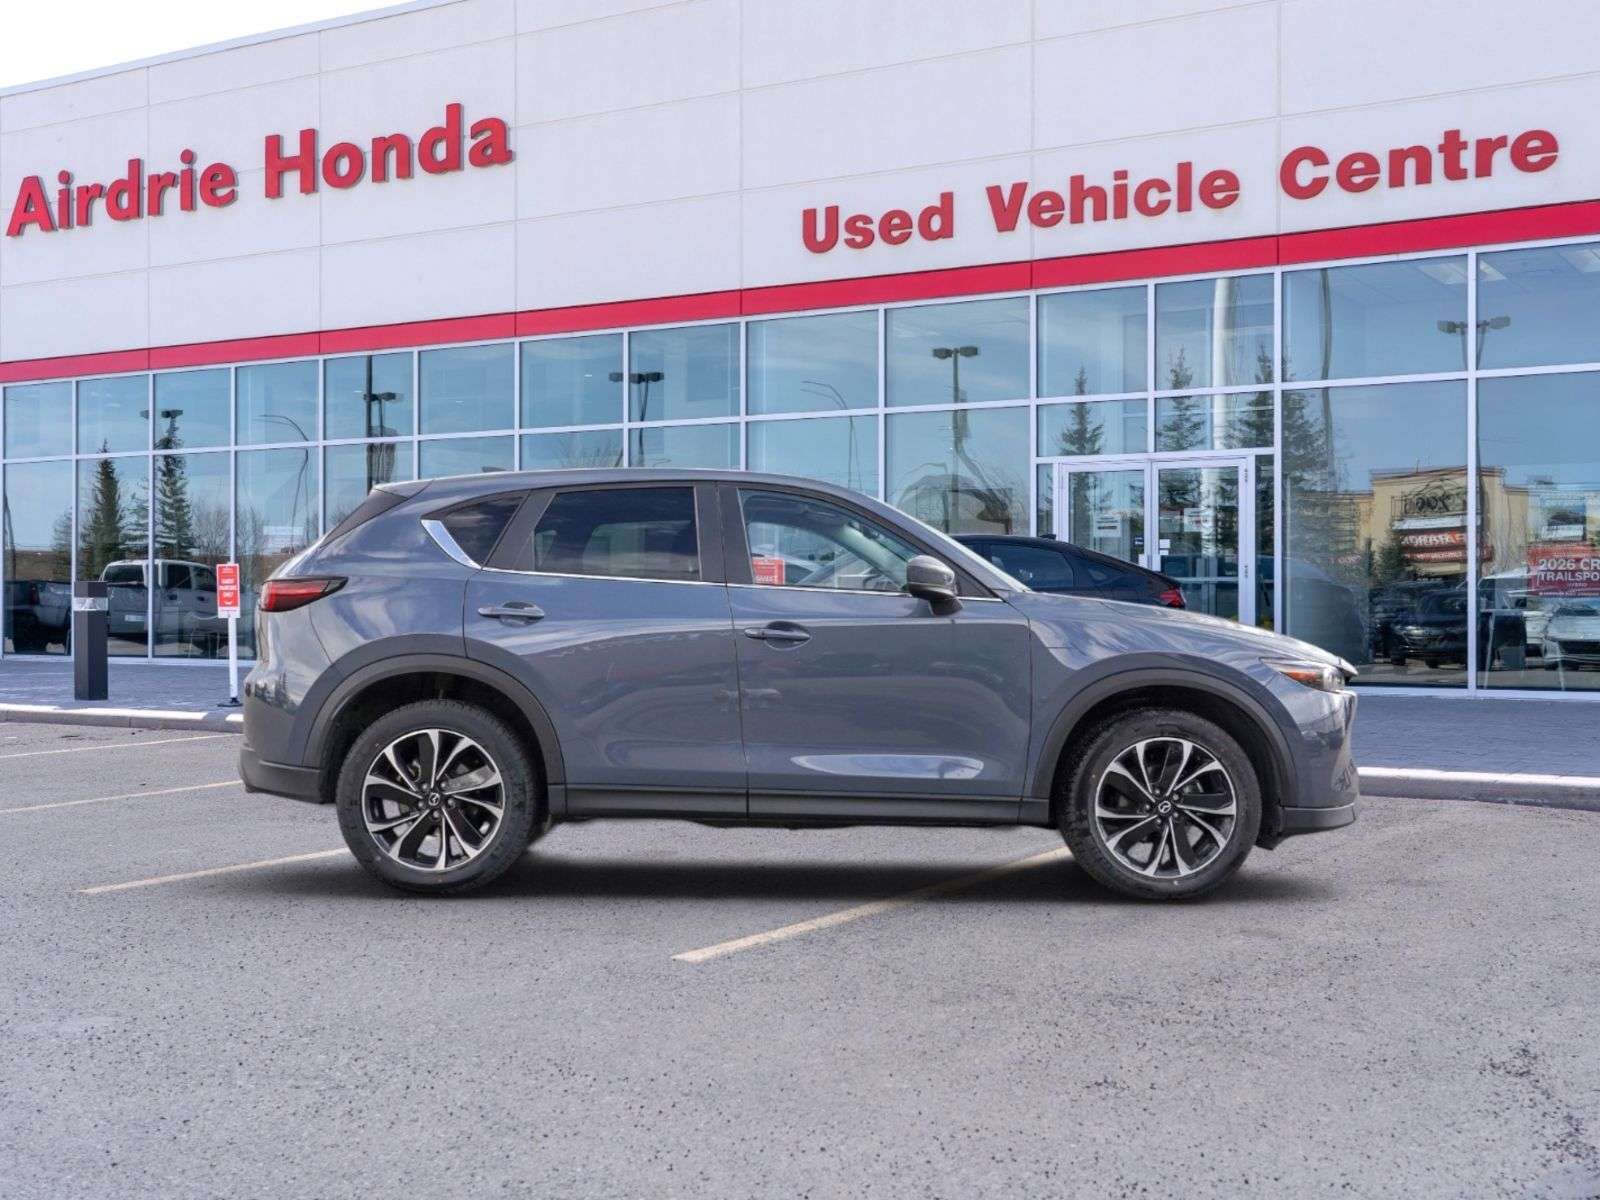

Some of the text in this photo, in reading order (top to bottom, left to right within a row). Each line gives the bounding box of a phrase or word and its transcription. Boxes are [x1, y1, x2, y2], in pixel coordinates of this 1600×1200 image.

[6, 102, 513, 237] Airdrie Honda
[802, 129, 1559, 254] Used Vehicle Centre
[1539, 558, 1576, 570] 2026
